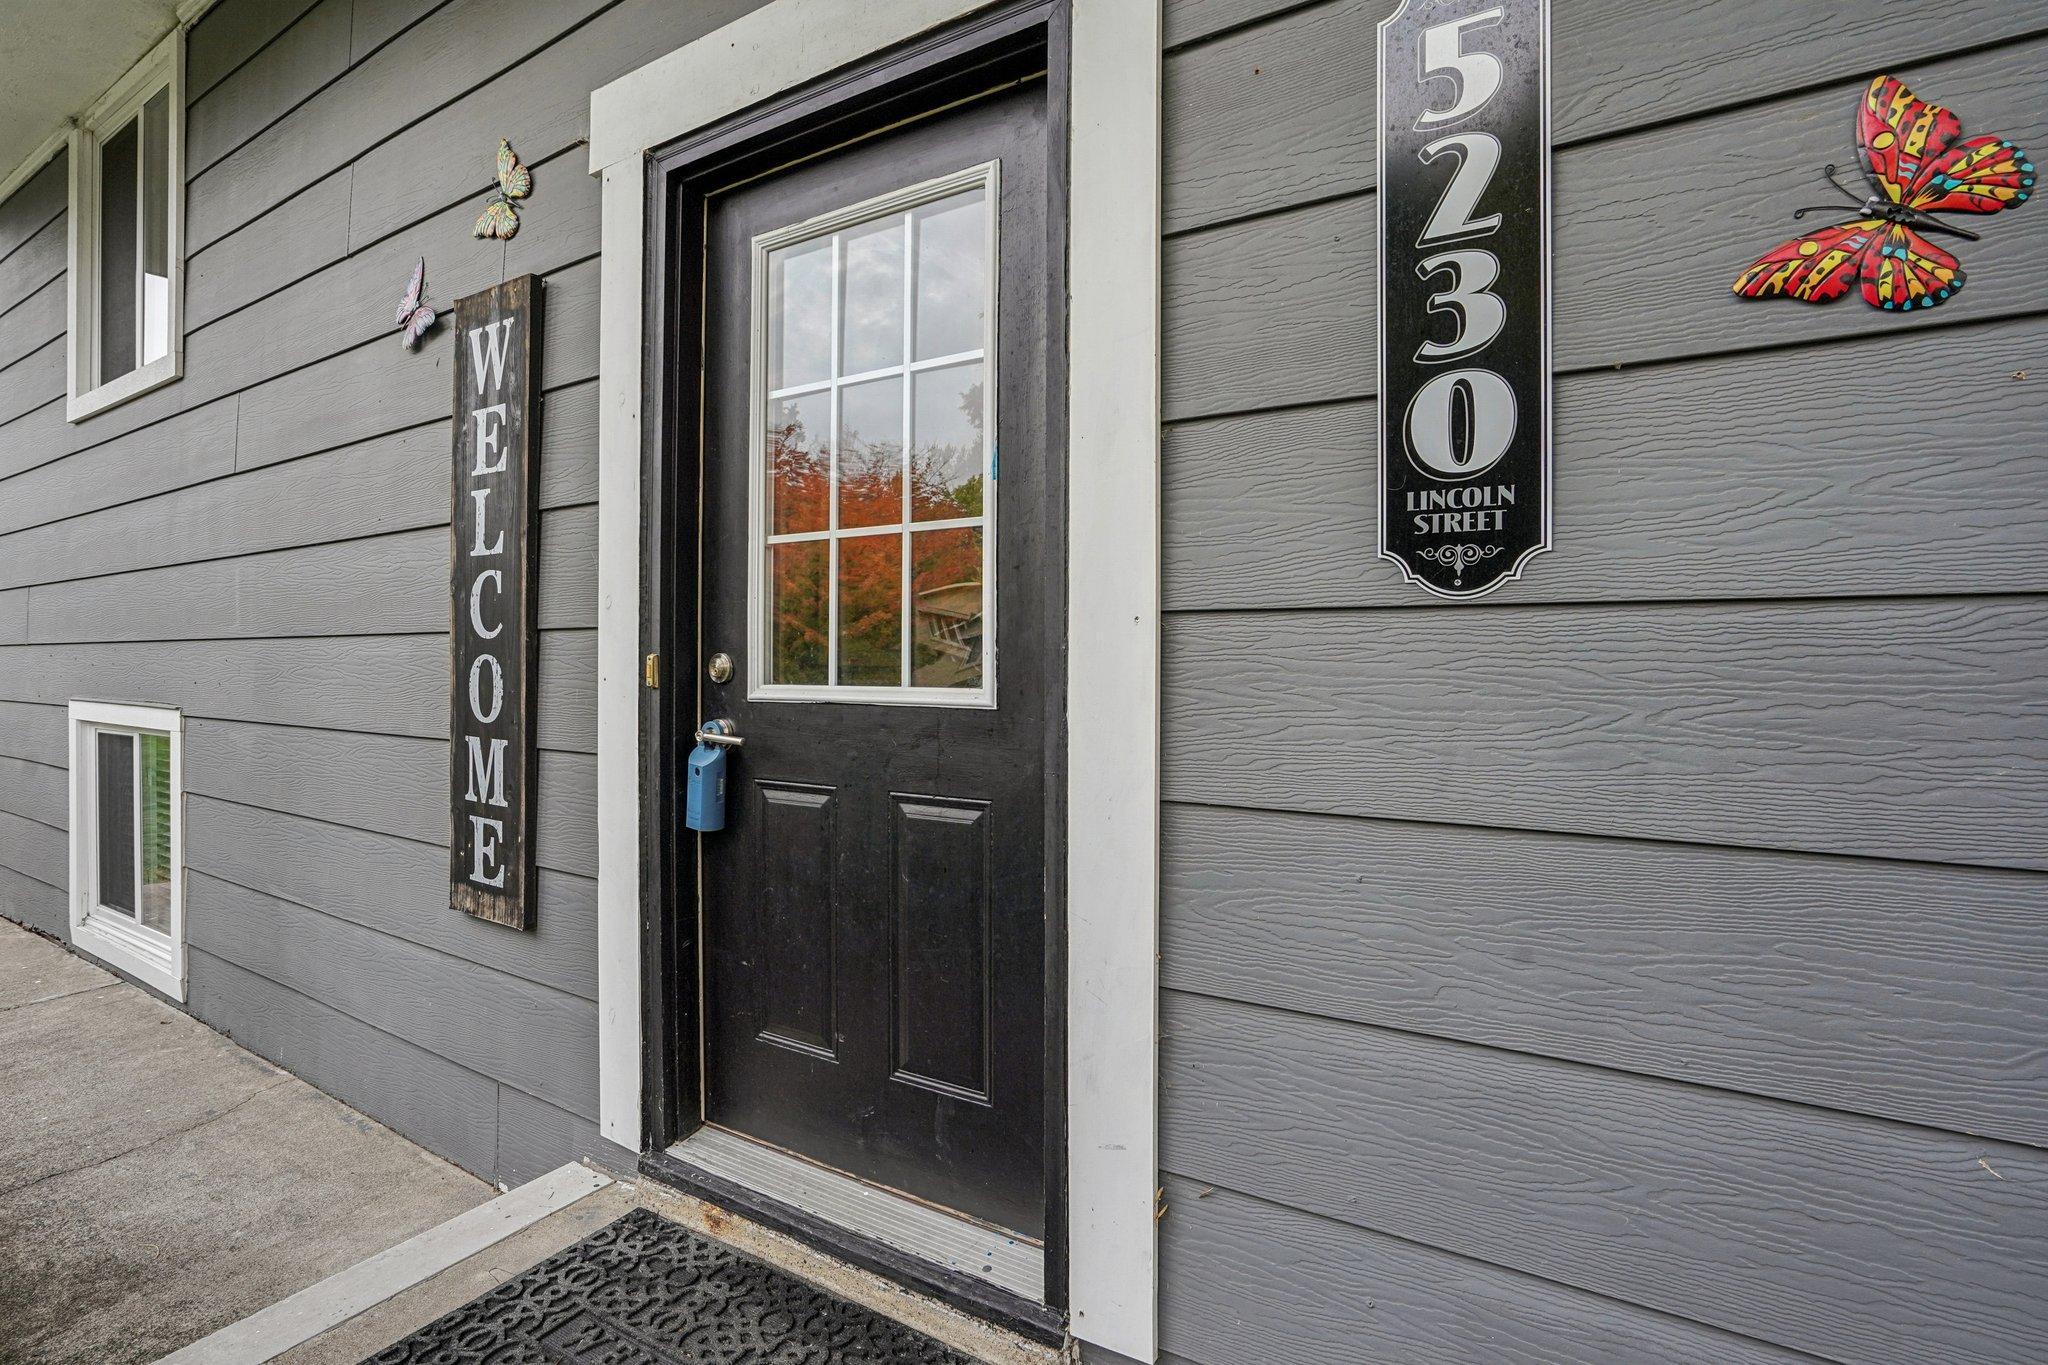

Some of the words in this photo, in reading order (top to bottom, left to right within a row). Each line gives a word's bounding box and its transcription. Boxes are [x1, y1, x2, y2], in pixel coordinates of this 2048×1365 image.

[1403, 5, 1518, 482] 5230
[465, 316, 515, 888] WELCOME
[1406, 484, 1516, 511] LINCOLN
[1413, 509, 1508, 535] STREET
